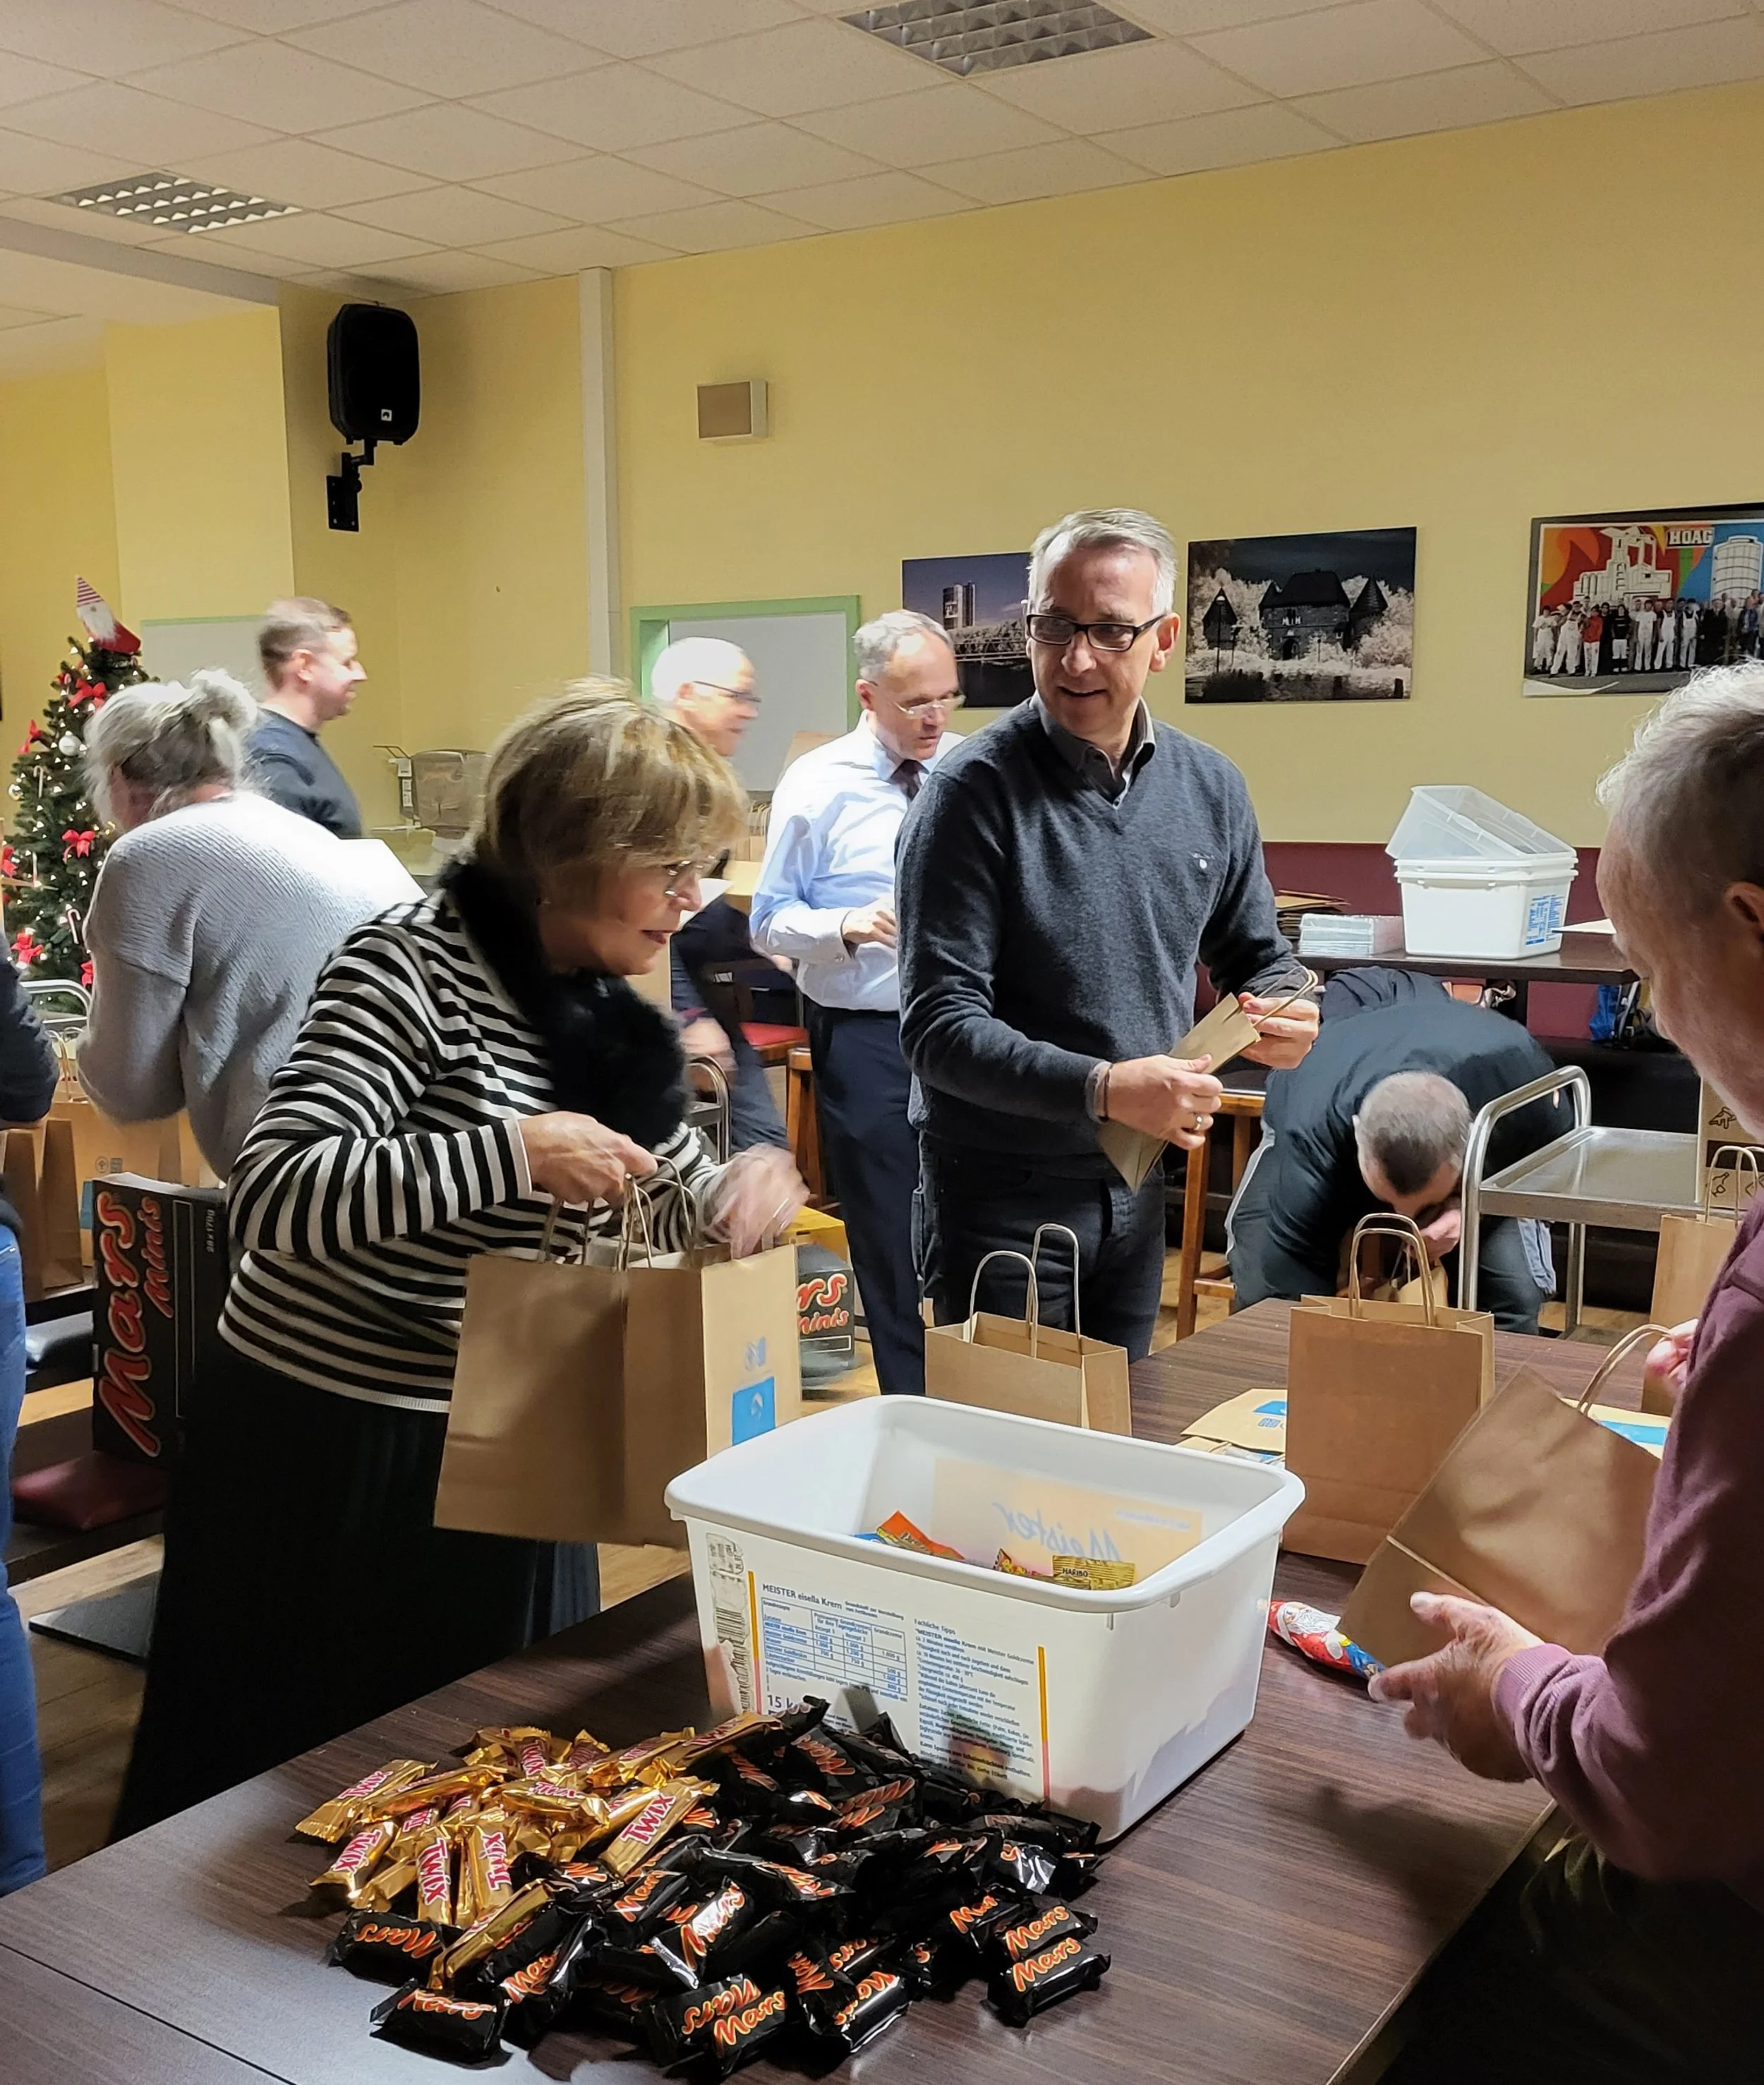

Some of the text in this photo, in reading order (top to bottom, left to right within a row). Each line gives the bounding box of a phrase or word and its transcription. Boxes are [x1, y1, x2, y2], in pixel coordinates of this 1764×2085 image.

[1669, 530, 1713, 545] HOAG
[797, 1273, 848, 1312] rs
[97, 1191, 162, 1458] Mars
[763, 1583, 841, 1609] MEISTER eisella Krem
[1062, 1568, 1089, 1578] HARIBO
[768, 1695, 783, 1708] 15
[620, 1792, 676, 1845] TWIX
[1005, 1906, 1070, 1962] Mars
[1013, 1938, 1082, 1993] Mars
[713, 1990, 787, 2058] Mars
